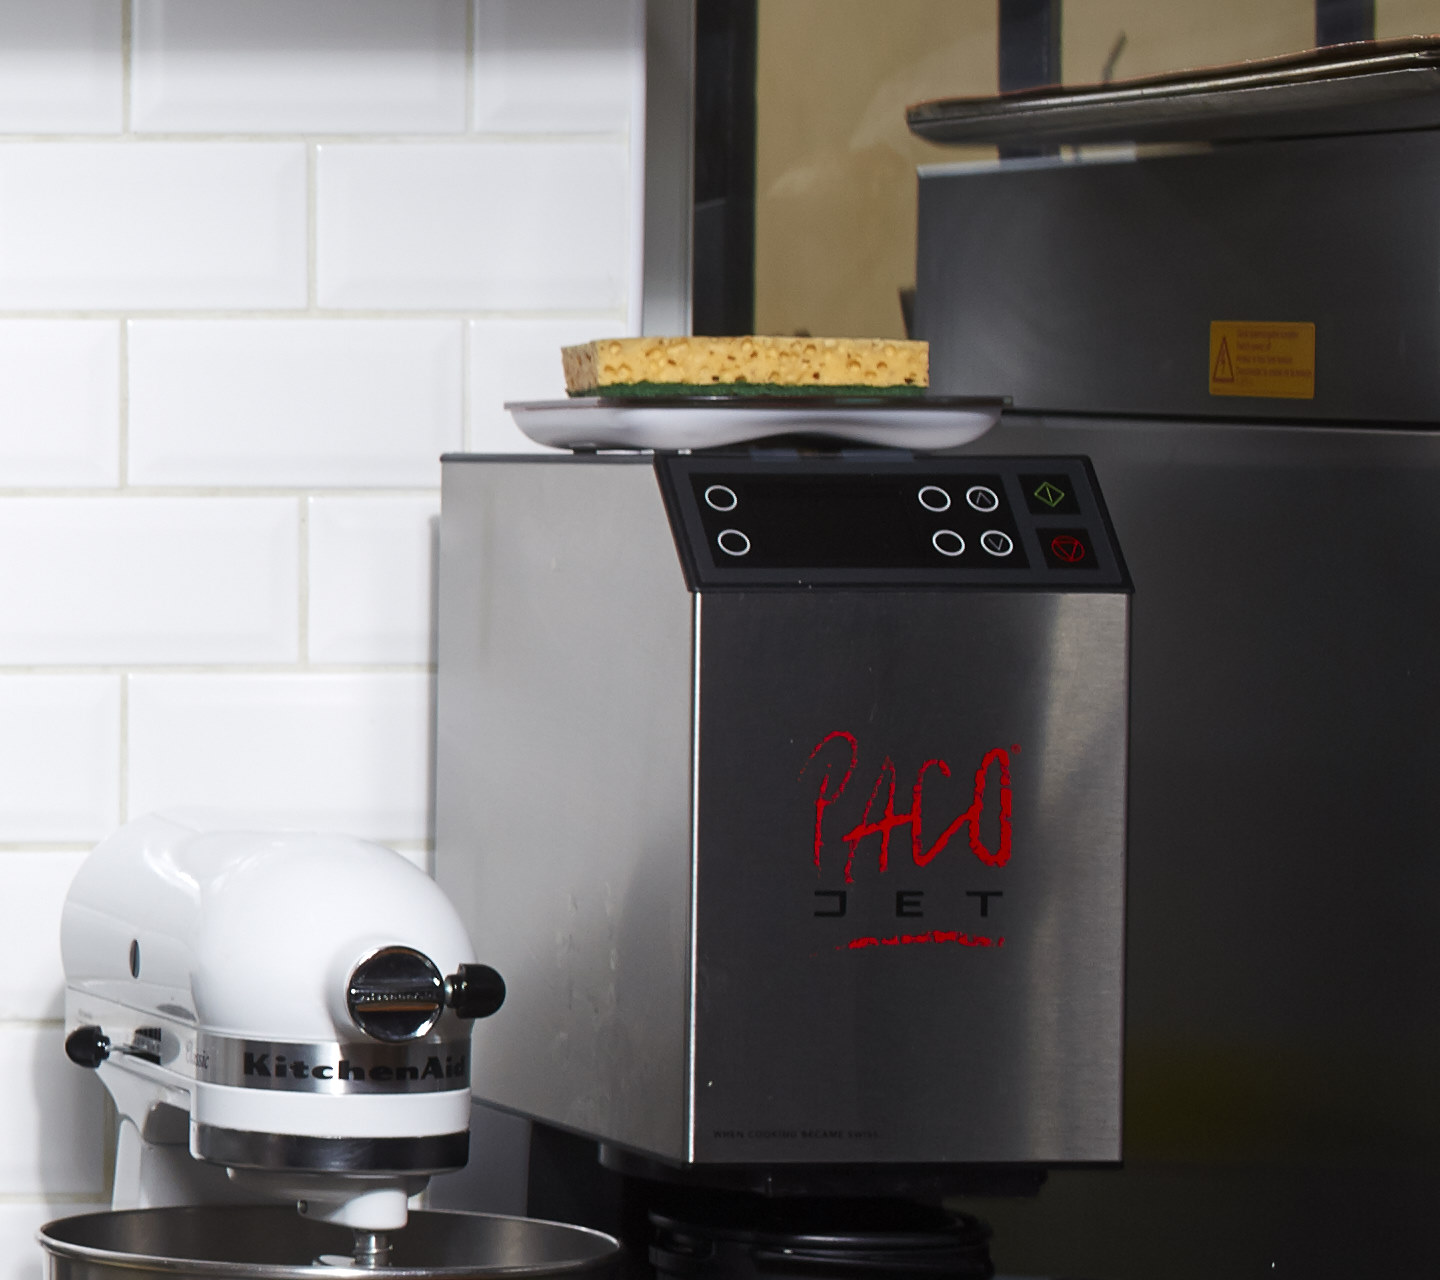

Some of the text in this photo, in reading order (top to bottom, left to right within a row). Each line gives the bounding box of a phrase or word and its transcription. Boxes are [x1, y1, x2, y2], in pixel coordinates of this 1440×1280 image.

[798, 731, 1012, 884] PACO
[813, 890, 1004, 918] JET
[243, 1051, 466, 1081] KitchenAid
